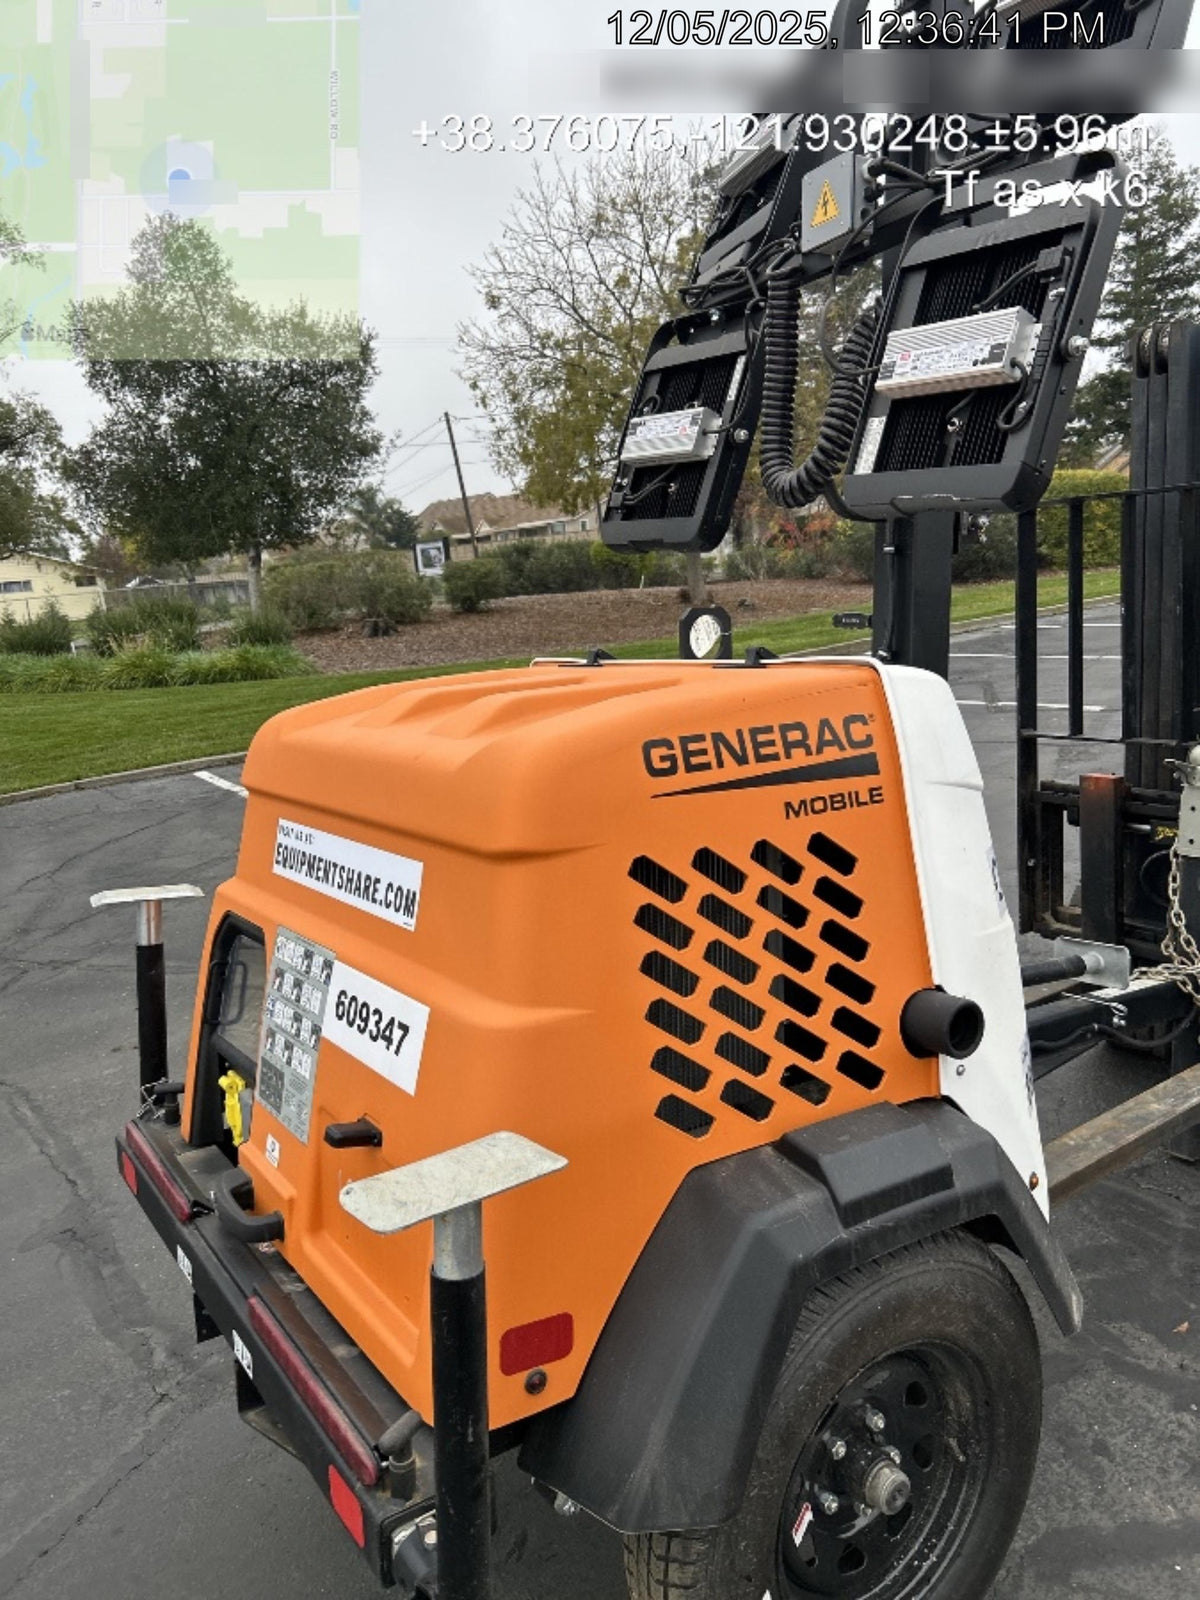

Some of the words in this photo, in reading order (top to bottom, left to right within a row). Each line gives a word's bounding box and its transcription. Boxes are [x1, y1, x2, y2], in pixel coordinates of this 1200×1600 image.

[641, 714, 874, 778] GENERAC
[784, 786, 884, 820] MOBILE
[275, 841, 417, 919] EQUIPMENTSHARE.COM
[335, 989, 410, 1057] 609347
